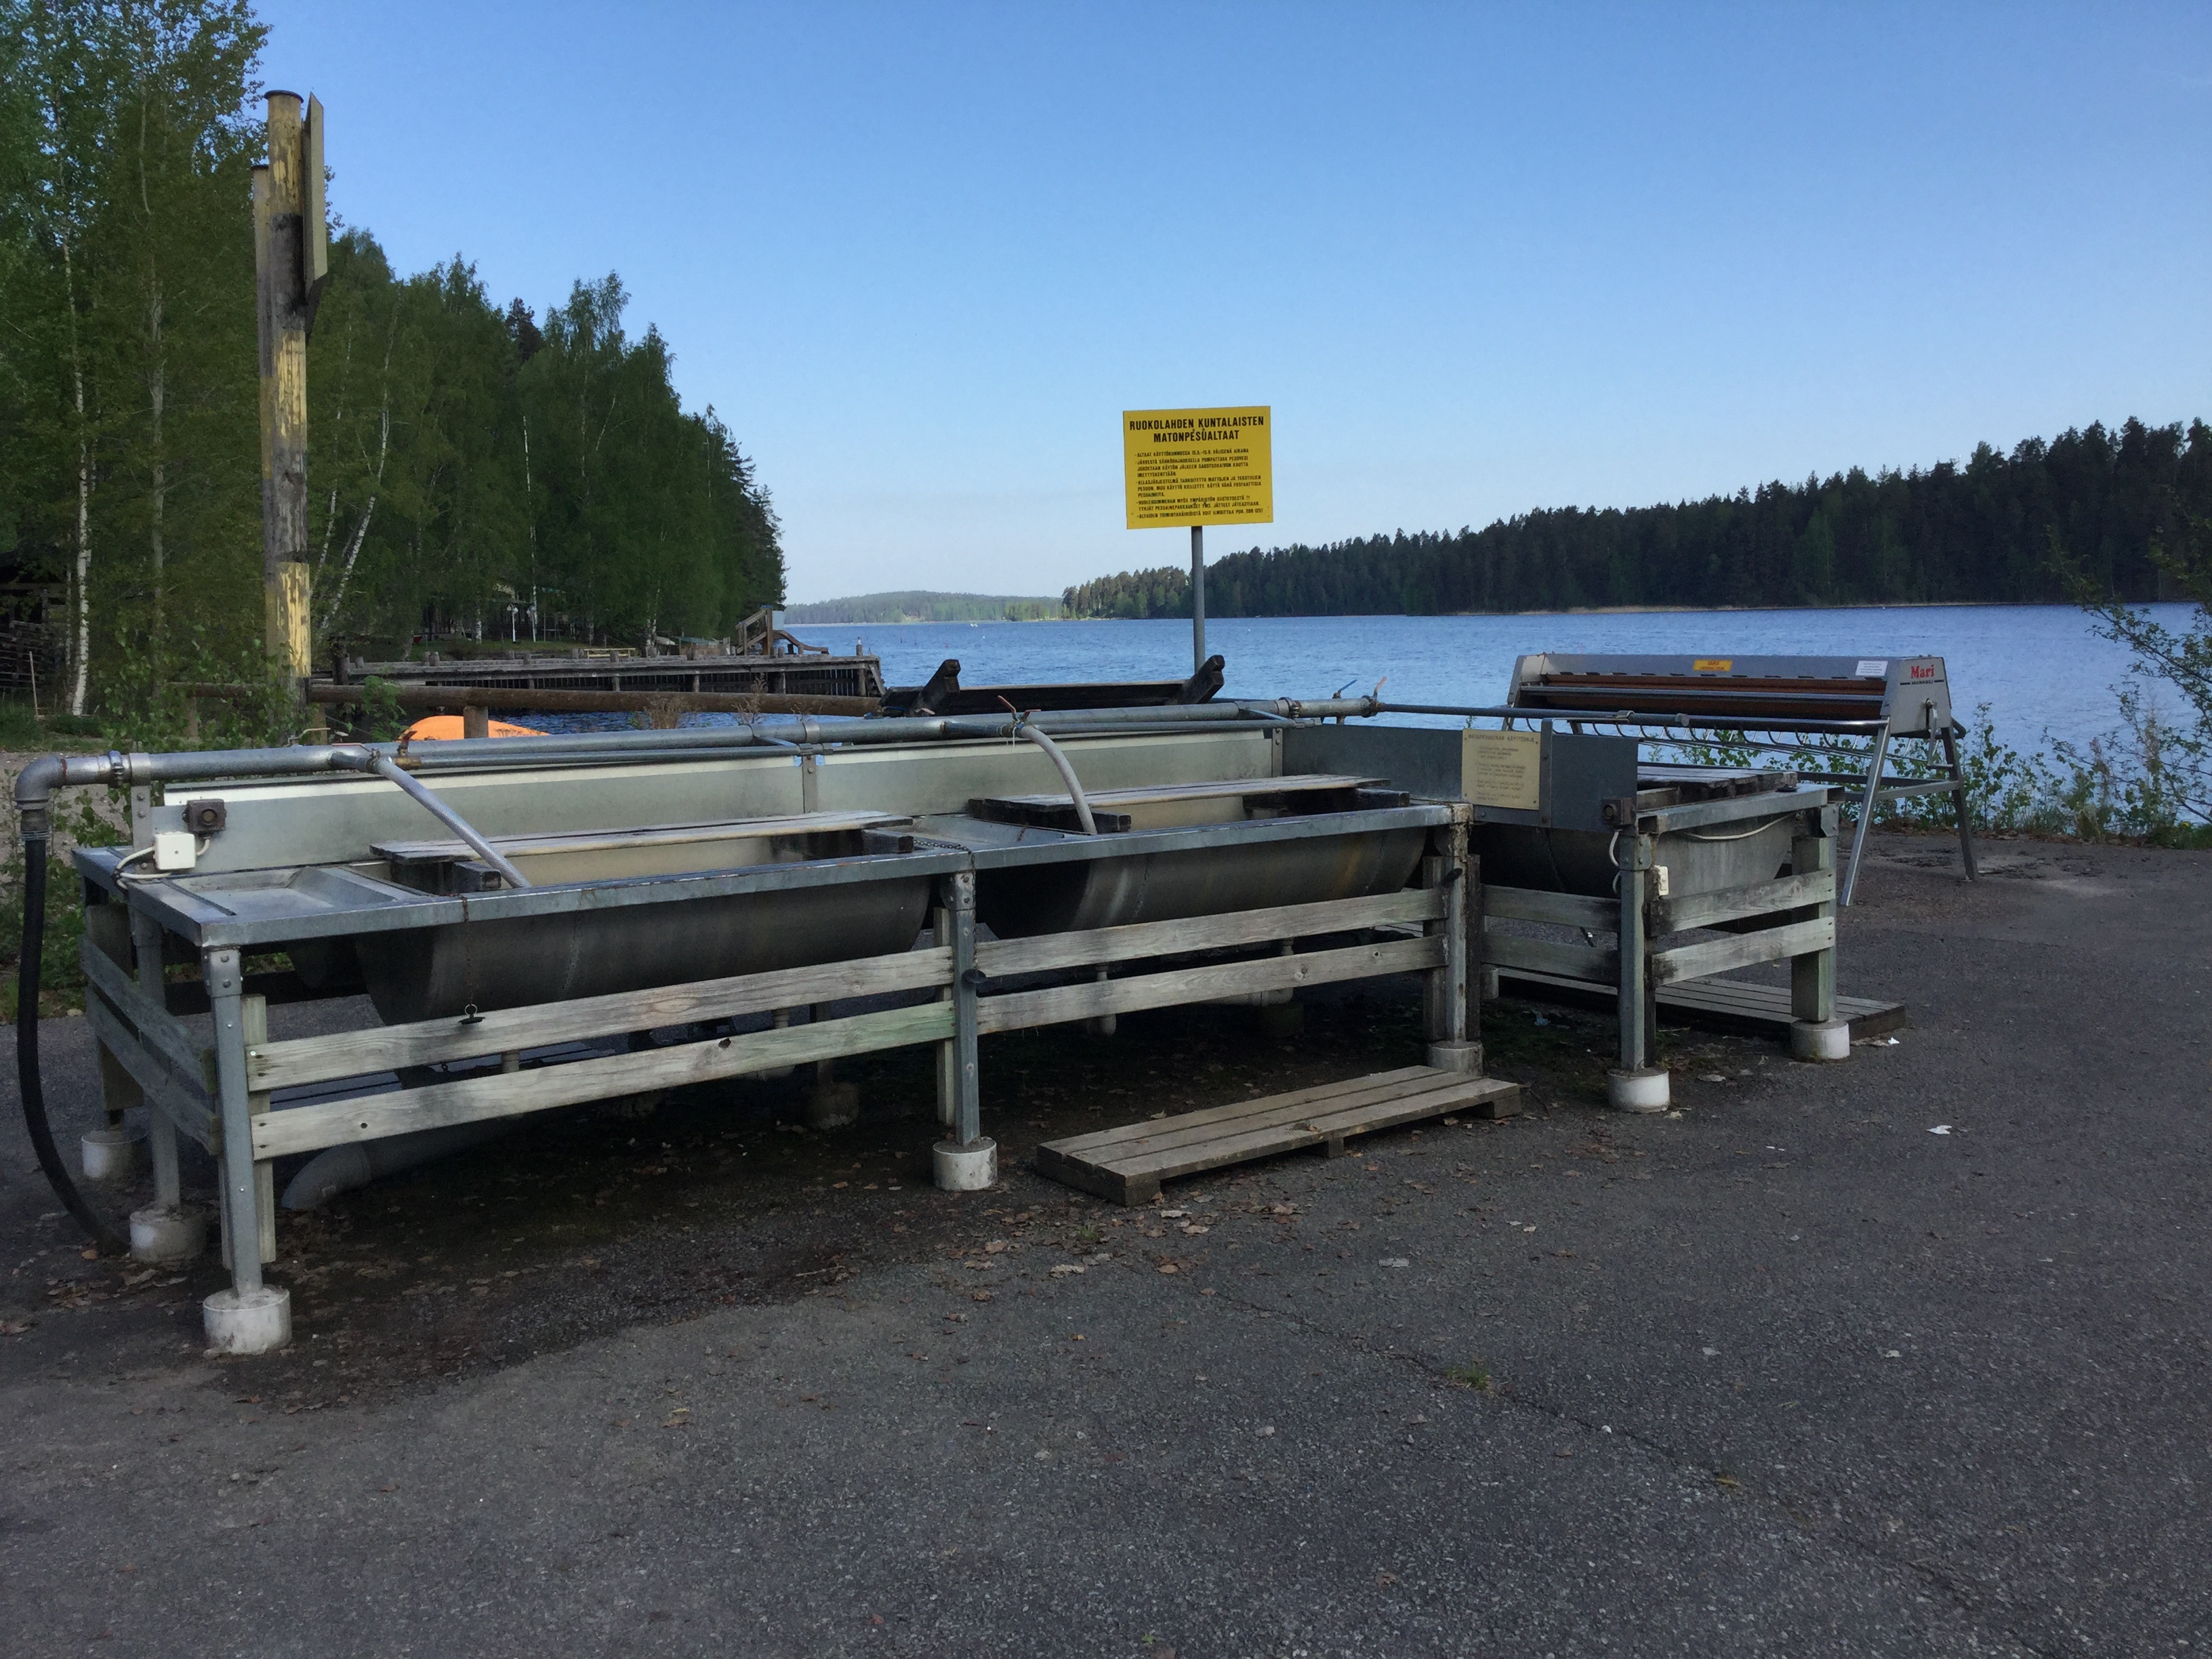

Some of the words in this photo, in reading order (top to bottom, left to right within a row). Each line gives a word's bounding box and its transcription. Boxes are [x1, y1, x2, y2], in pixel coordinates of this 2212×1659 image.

[1130, 419, 1193, 430] RUOKOLAHDEN
[1198, 416, 1264, 428] KUNTALAISTEN
[1153, 430, 1240, 443] MATONPESUALTAAT
[1910, 664, 1935, 679] Mari
